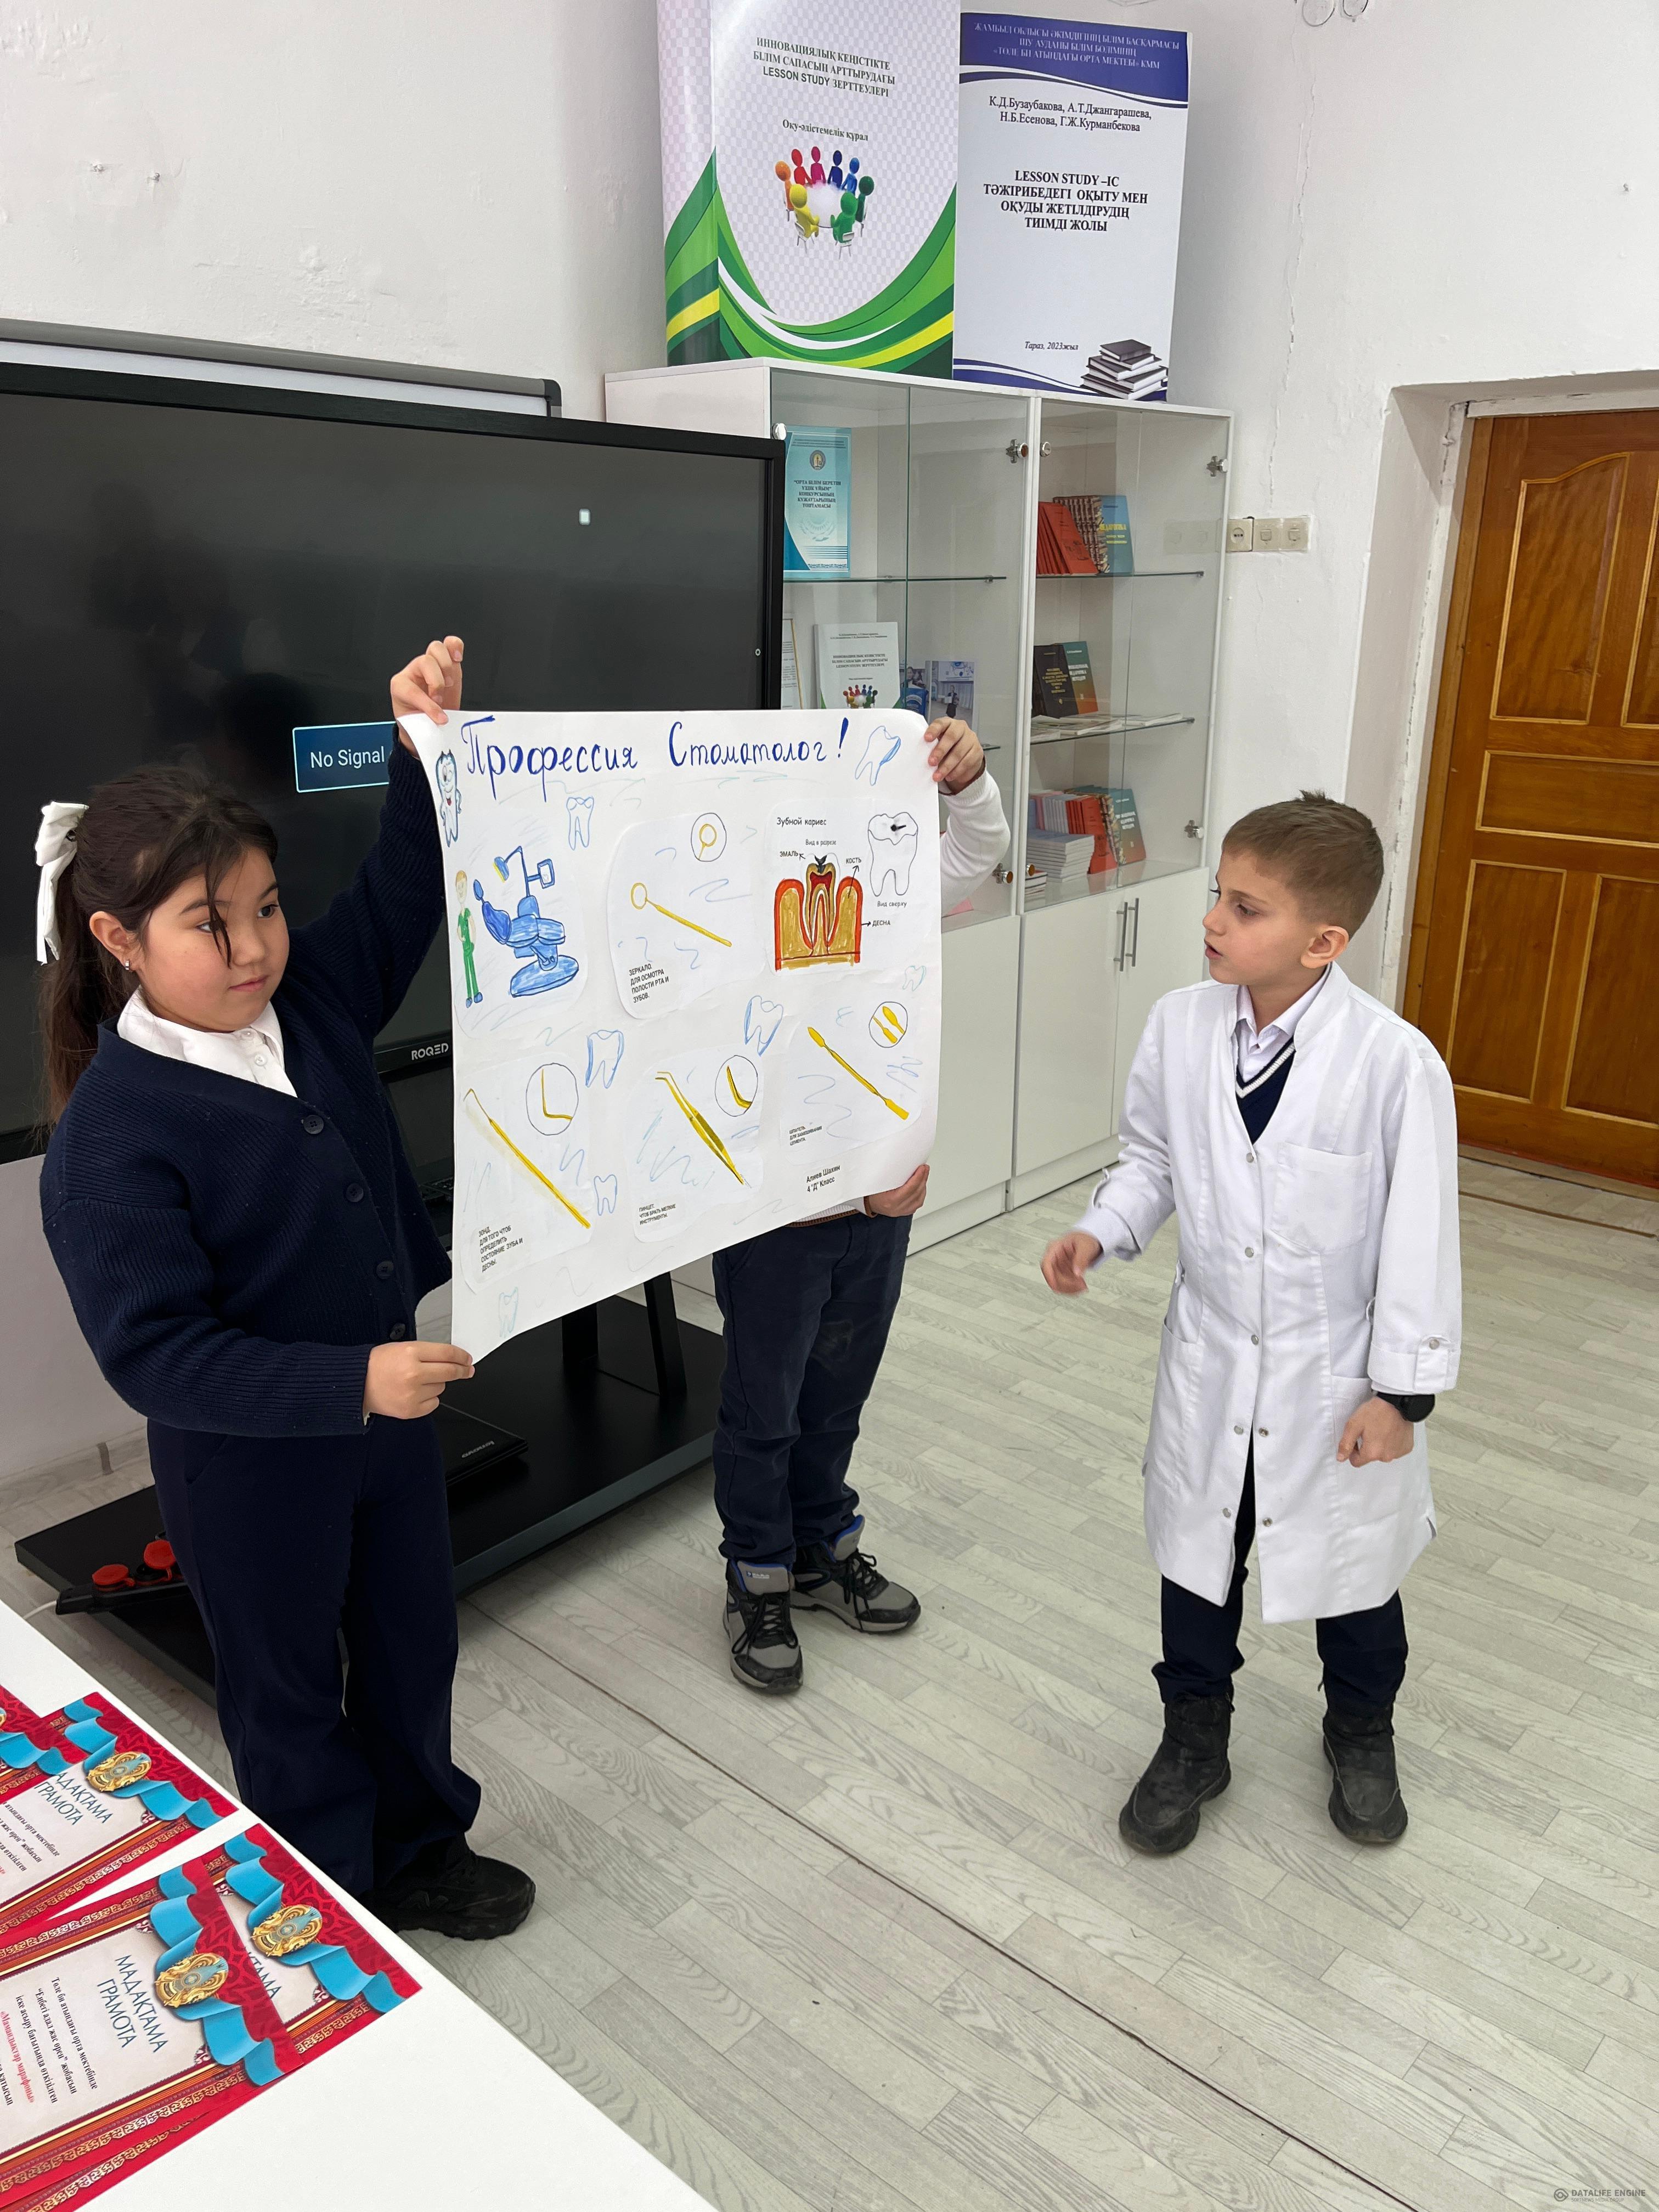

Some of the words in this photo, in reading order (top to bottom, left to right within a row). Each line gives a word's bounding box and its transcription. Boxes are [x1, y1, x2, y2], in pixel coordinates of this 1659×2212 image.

[974, 22, 1012, 34] ЖАМБЫЛ
[757, 37, 836, 61] ИННОВАЦИЯЛЫҚ
[838, 52, 890, 70] КЕҢІСТІКТЕ
[1080, 54, 1100, 63] ОРТА
[1141, 59, 1160, 69] КММ
[753, 50, 781, 64] БІЛІМ
[783, 56, 828, 72] САПАСЫН
[831, 66, 895, 85] АРТТЫРУДАҒЫ
[763, 66, 798, 81] LESSON
[801, 73, 830, 86] STUDY
[832, 78, 889, 97] ЗЕРТТЕУЛЕРІ
[989, 95, 1065, 113] К.Д.Бузаубакова,
[1068, 102, 1152, 120] А.Т.Джангарашева,
[1000, 111, 1058, 127] Н.Б.Есенова,
[1060, 116, 1140, 132] Г.Ж.Курманбекова
[1015, 170, 1059, 183] LESSON
[1062, 173, 1099, 185] STUDY
[984, 184, 1071, 200] ТӘЖІРИБЕДЕГІ
[1077, 189, 1120, 203] ОҚЫТУ
[1122, 192, 1148, 204] МЕН
[1001, 201, 1043, 213] ОҚУДЫ
[1046, 203, 1130, 219] ЖЕТІЛДІРУДІҢ
[1024, 217, 1068, 231] ТИІМДІ
[1070, 219, 1108, 232] ЖОЛЫ
[1025, 341, 1045, 351] Тараз,
[1047, 342, 1079, 350] 2023жыл
[310, 751, 333, 769] No
[337, 746, 385, 769] Signal
[461, 715, 638, 803] Профессия
[776, 817, 802, 827] Зубной
[630, 976, 641, 986] ДЛЯ
[641, 969, 664, 981] ОСМОТРА
[631, 981, 654, 994] ПОЛОСТИ
[655, 978, 664, 986] РТА
[411, 1042, 449, 1060] ROQED
[806, 1172, 822, 1183] Алиев
[820, 1177, 835, 1187] Класс
[479, 1237, 488, 1247] ДЛЯ
[488, 1231, 499, 1240] ТОГО
[506, 1239, 518, 1250] ЗУБА
[33, 1781, 84, 1825] ГРАМОТА
[55, 1772, 113, 1824] АДАҚТАМА
[25, 1821, 37, 1835] орта
[21, 1843, 43, 1863] жобасын
[16, 1995, 25, 2009] іске
[57, 1993, 66, 2002] би
[114, 1955, 168, 2053] МАДАҚТАМА
[20, 2008, 32, 2029] асыру
[60, 2002, 77, 2036] атындағы
[97, 1978, 138, 2048] ГРАМОТА
[27, 2028, 46, 2068] бағытында
[71, 2035, 83, 2052] орта
[43, 2013, 53, 2030] адал
[49, 2029, 59, 2043] жас
[61, 2063, 77, 2095] жобасын
[80, 2052, 98, 2090] мектебінде
